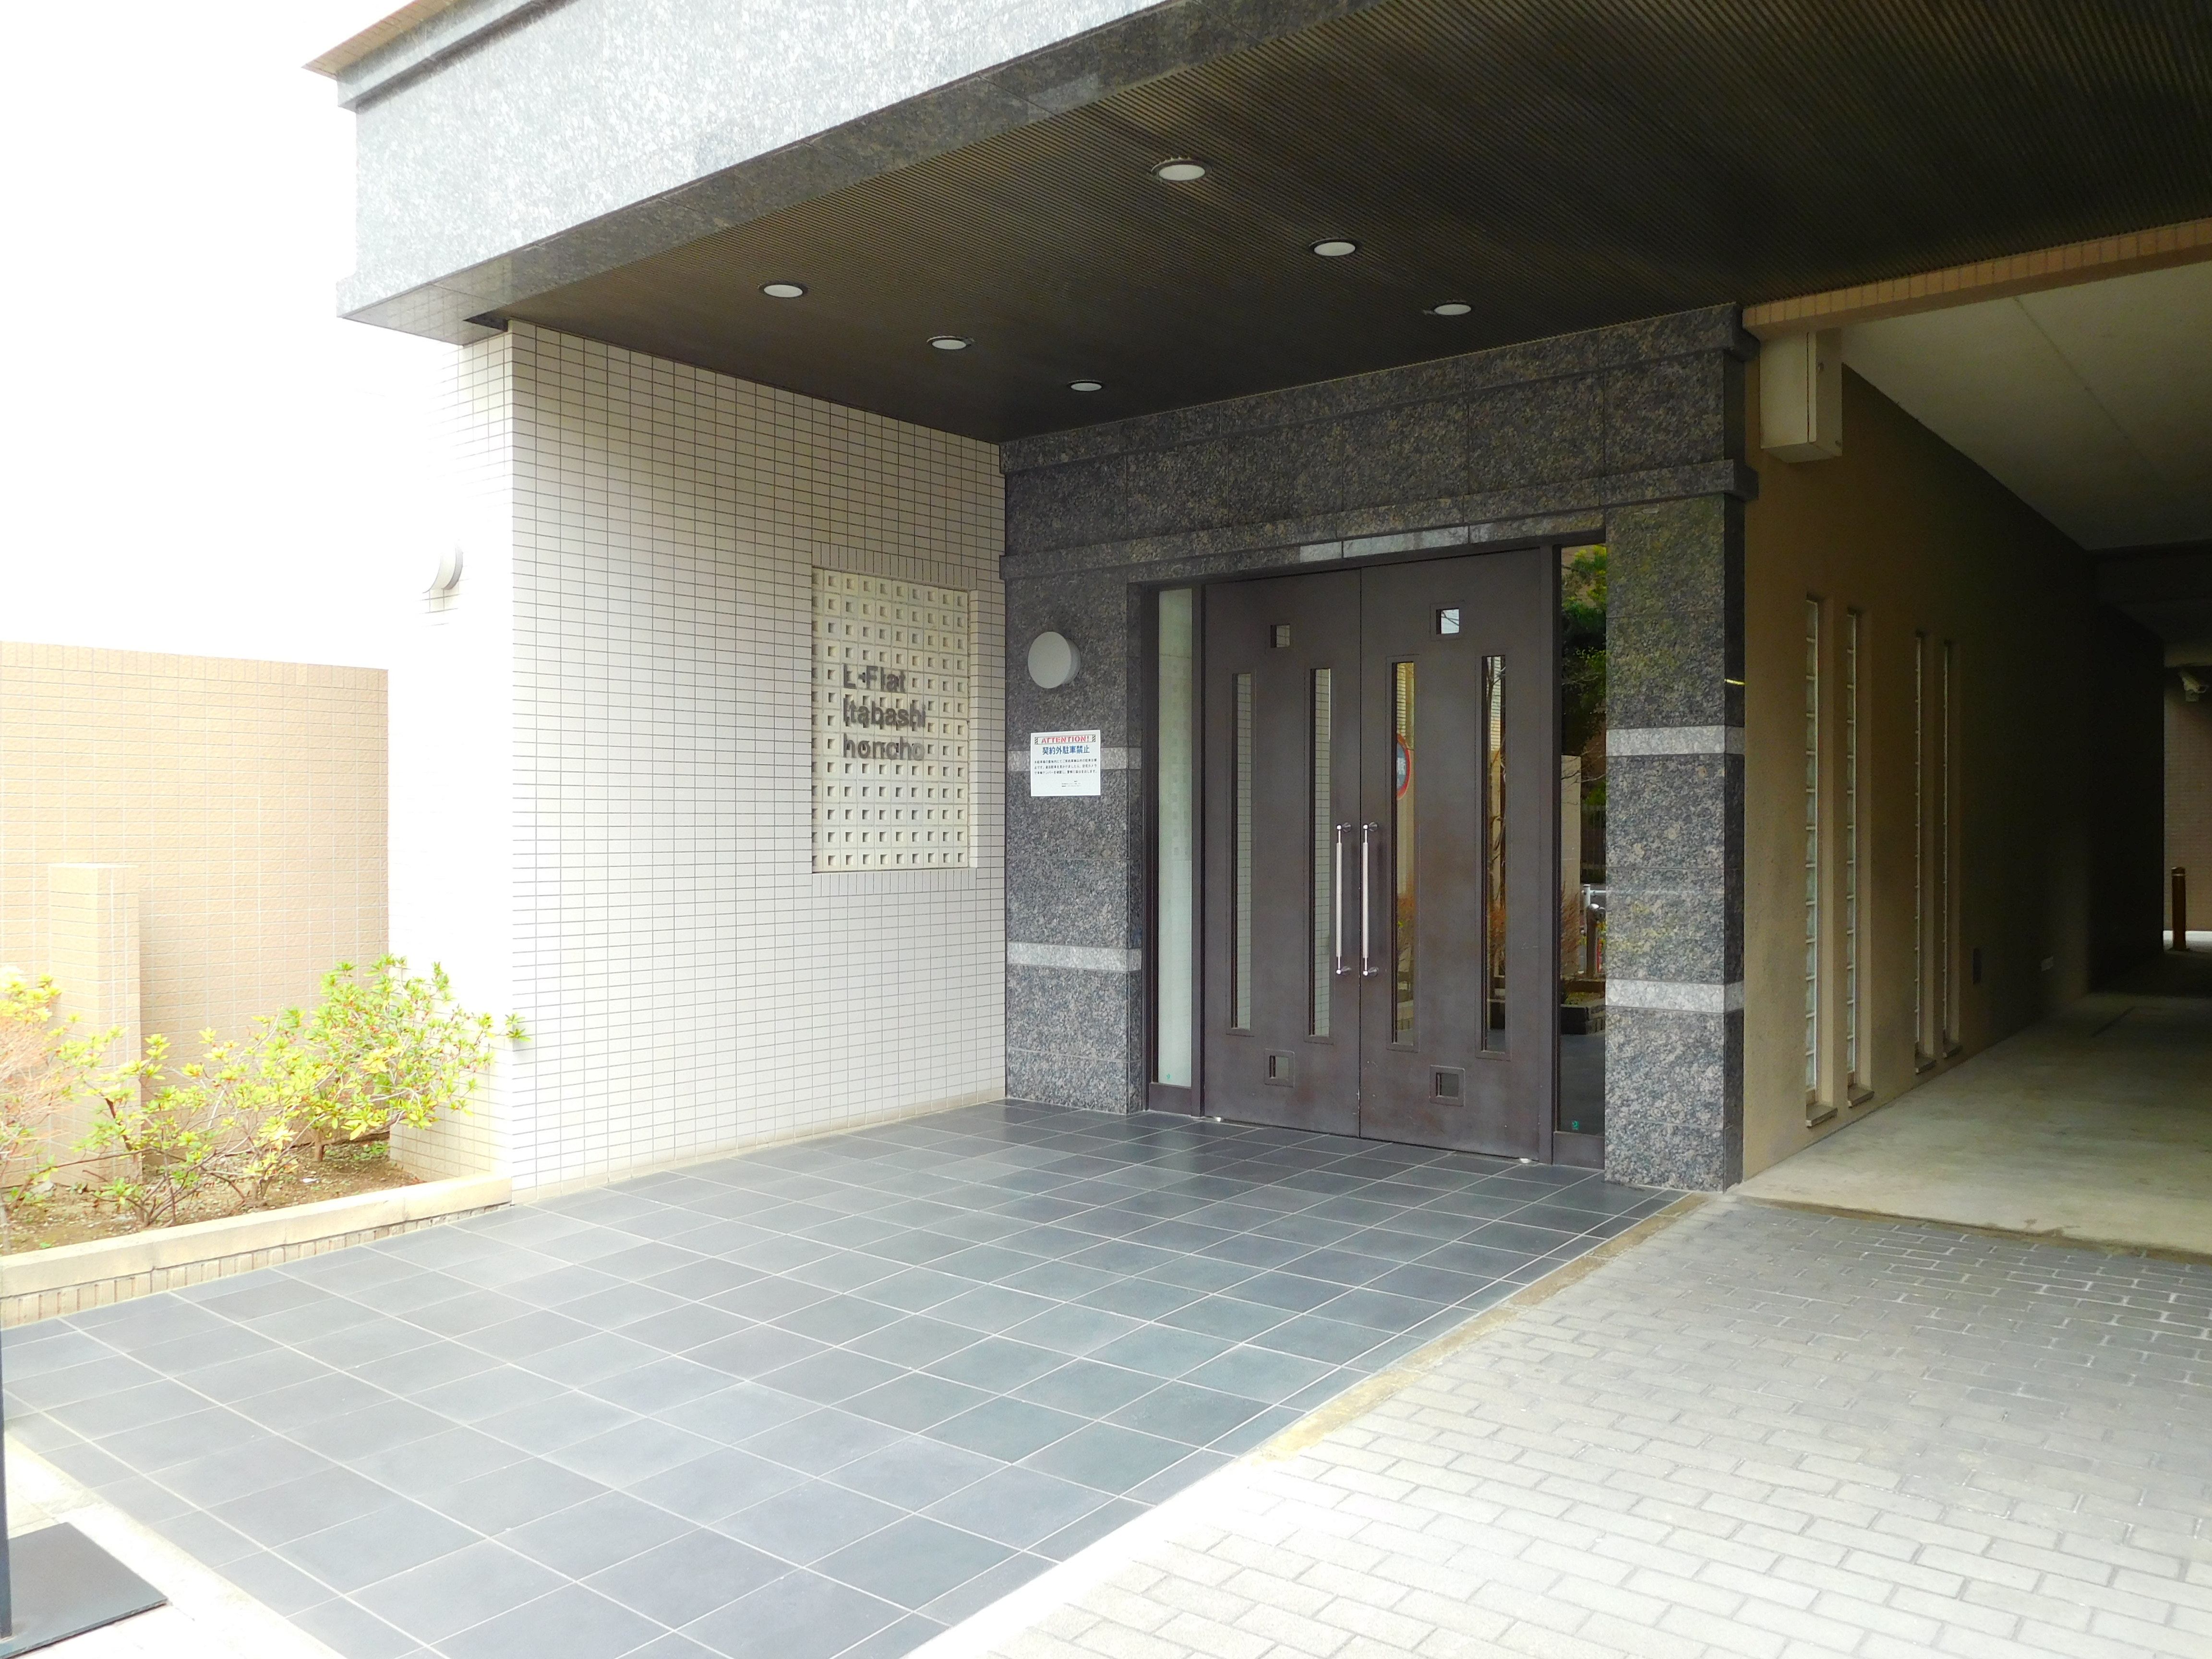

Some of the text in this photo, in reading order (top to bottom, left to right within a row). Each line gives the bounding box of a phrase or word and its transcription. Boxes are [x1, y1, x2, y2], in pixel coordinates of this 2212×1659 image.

[843, 697, 926, 728] Itabashi
[843, 733, 925, 761] honcho
[1042, 745, 1090, 755] 契約外駐車禁止
